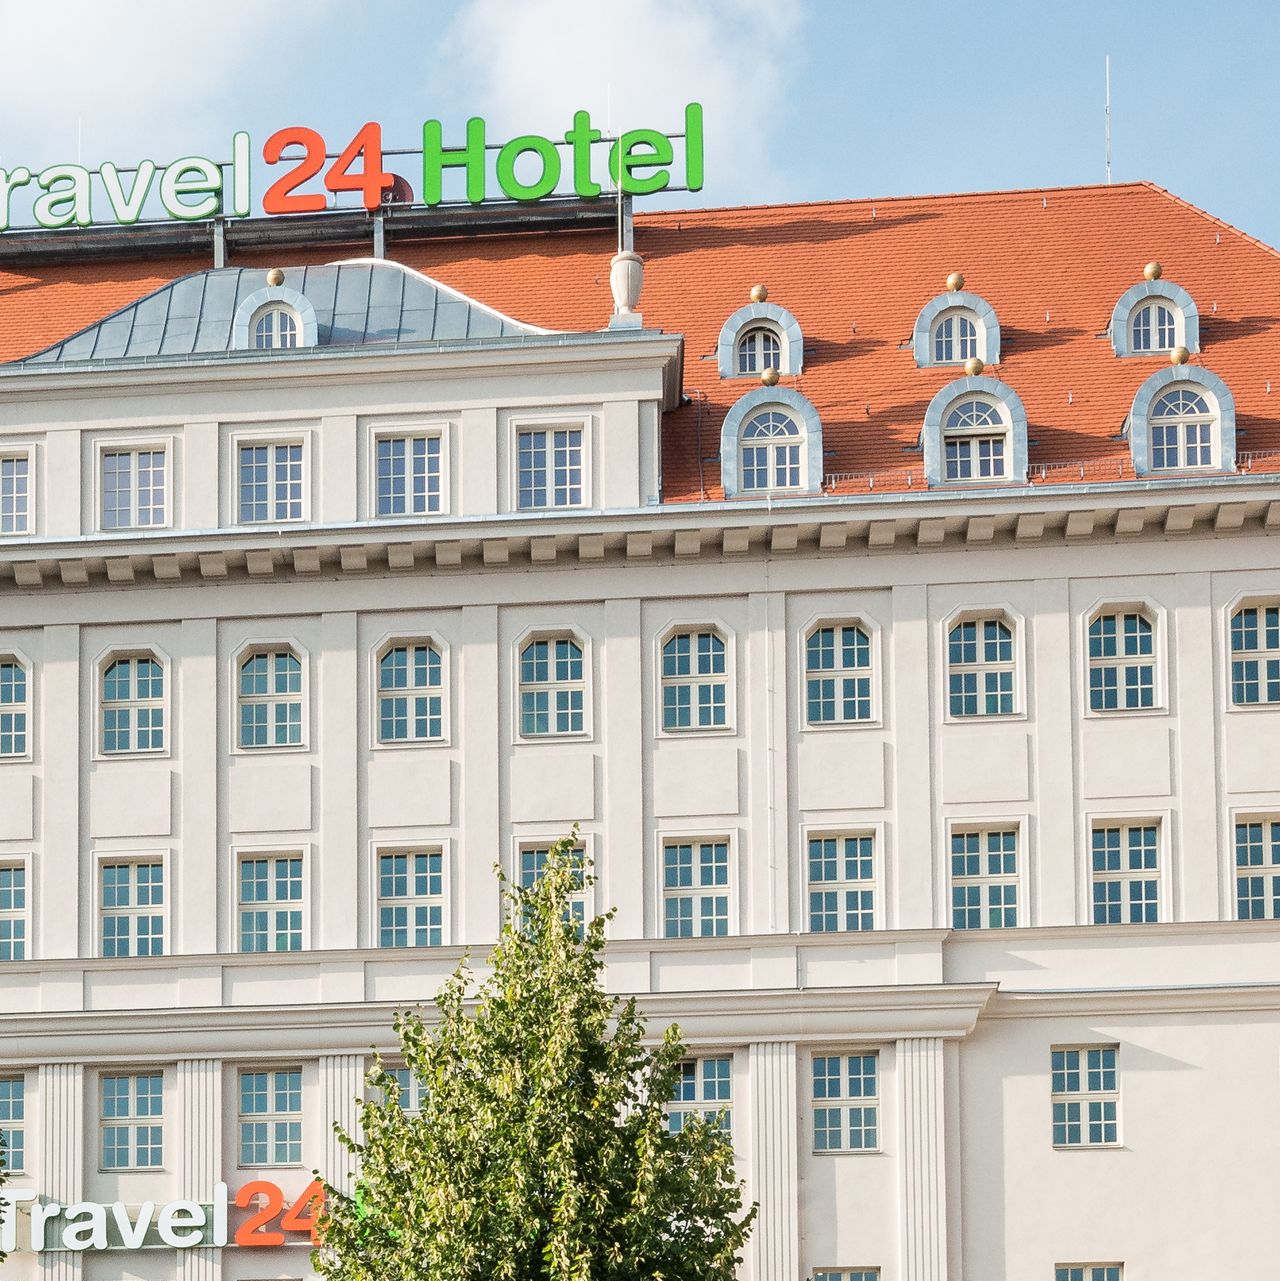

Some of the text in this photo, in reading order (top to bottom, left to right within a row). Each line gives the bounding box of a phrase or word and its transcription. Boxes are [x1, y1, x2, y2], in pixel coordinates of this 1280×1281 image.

[263, 122, 394, 215] 24
[422, 102, 704, 206] Hotel
[235, 1180, 331, 1247] 24
